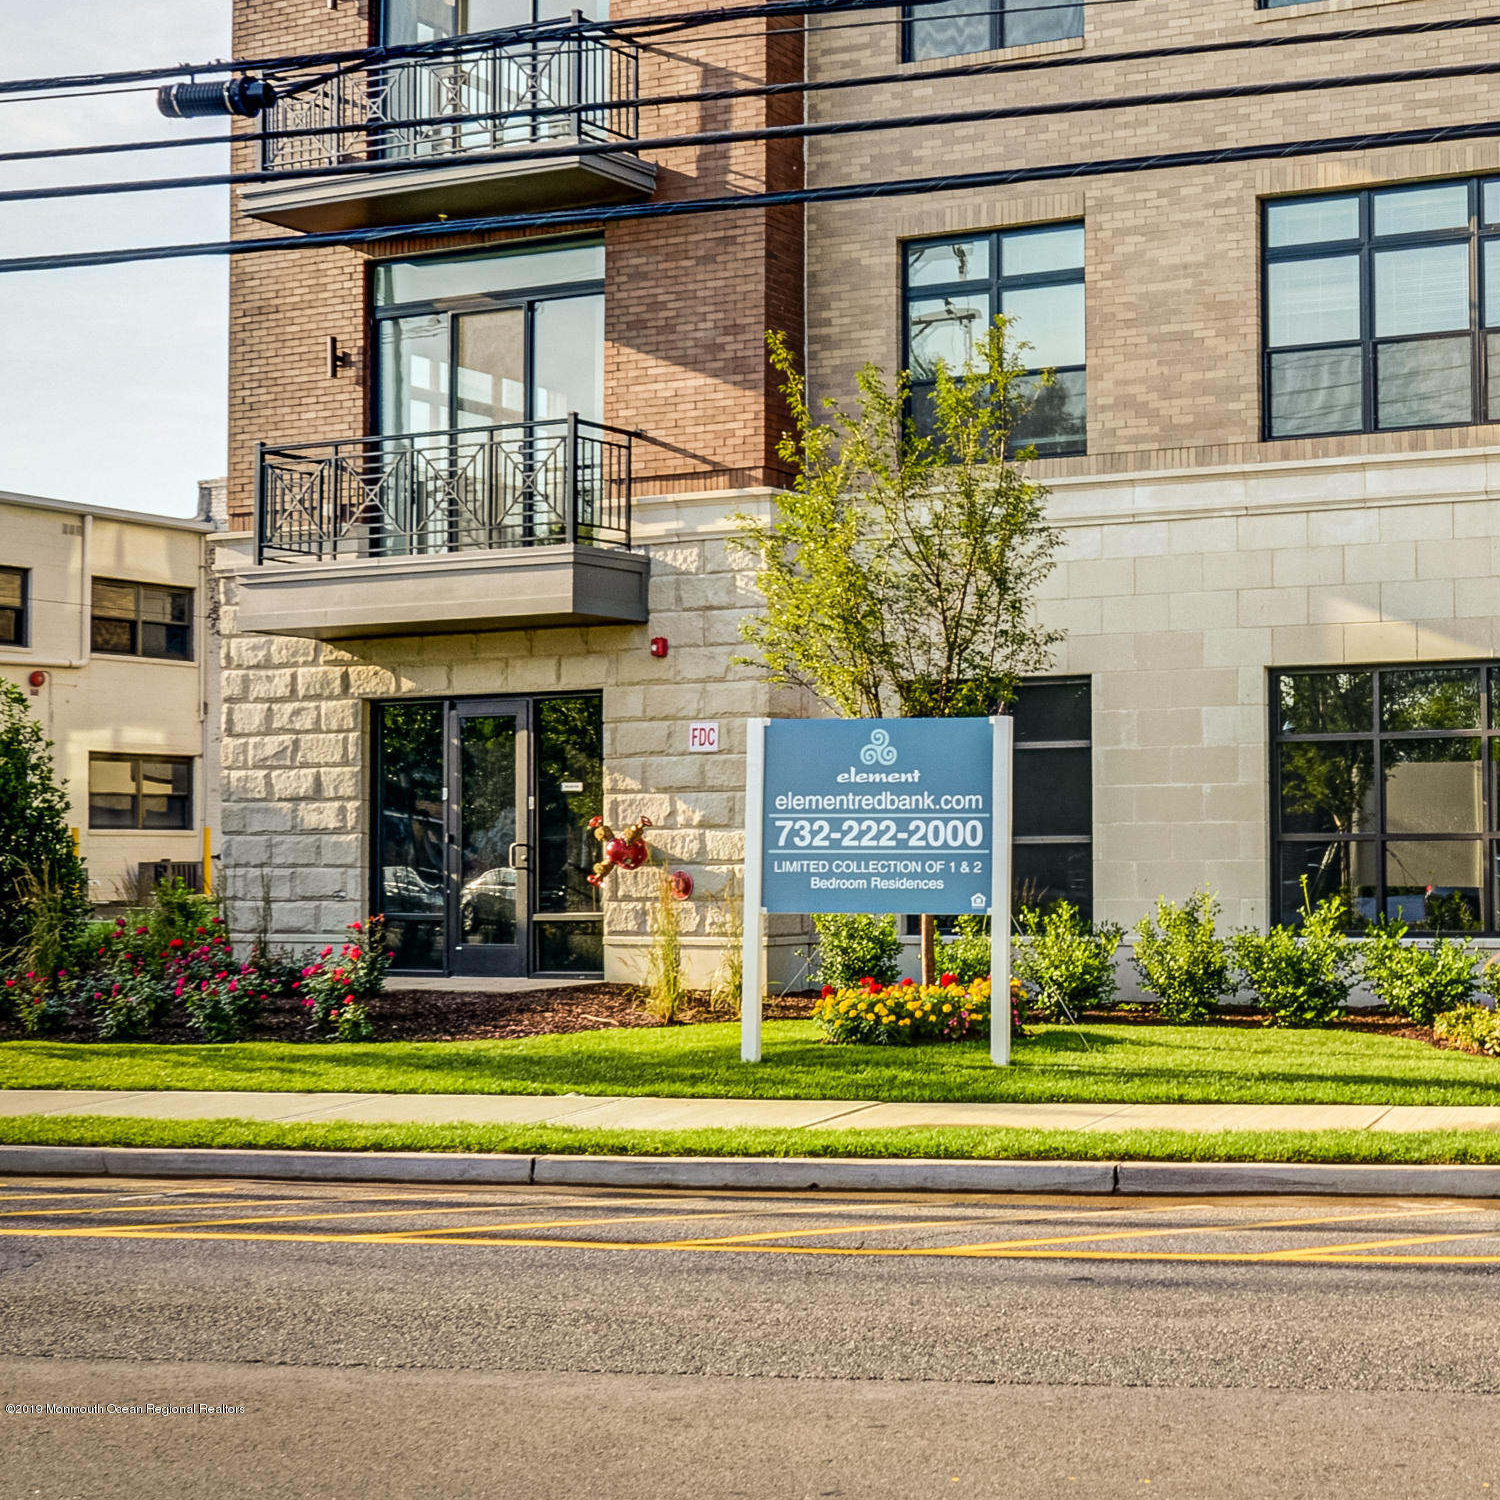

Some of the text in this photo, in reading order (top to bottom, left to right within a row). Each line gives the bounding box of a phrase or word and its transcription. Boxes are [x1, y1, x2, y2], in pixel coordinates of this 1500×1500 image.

[691, 727, 716, 747] FDC
[836, 766, 921, 783] element
[775, 791, 983, 810] elementredbank.com
[775, 819, 984, 847] 732-222-2000
[774, 861, 983, 873] LIMITED COLLECTION OF 1 & 2
[810, 877, 944, 890] Bedroom Residences
